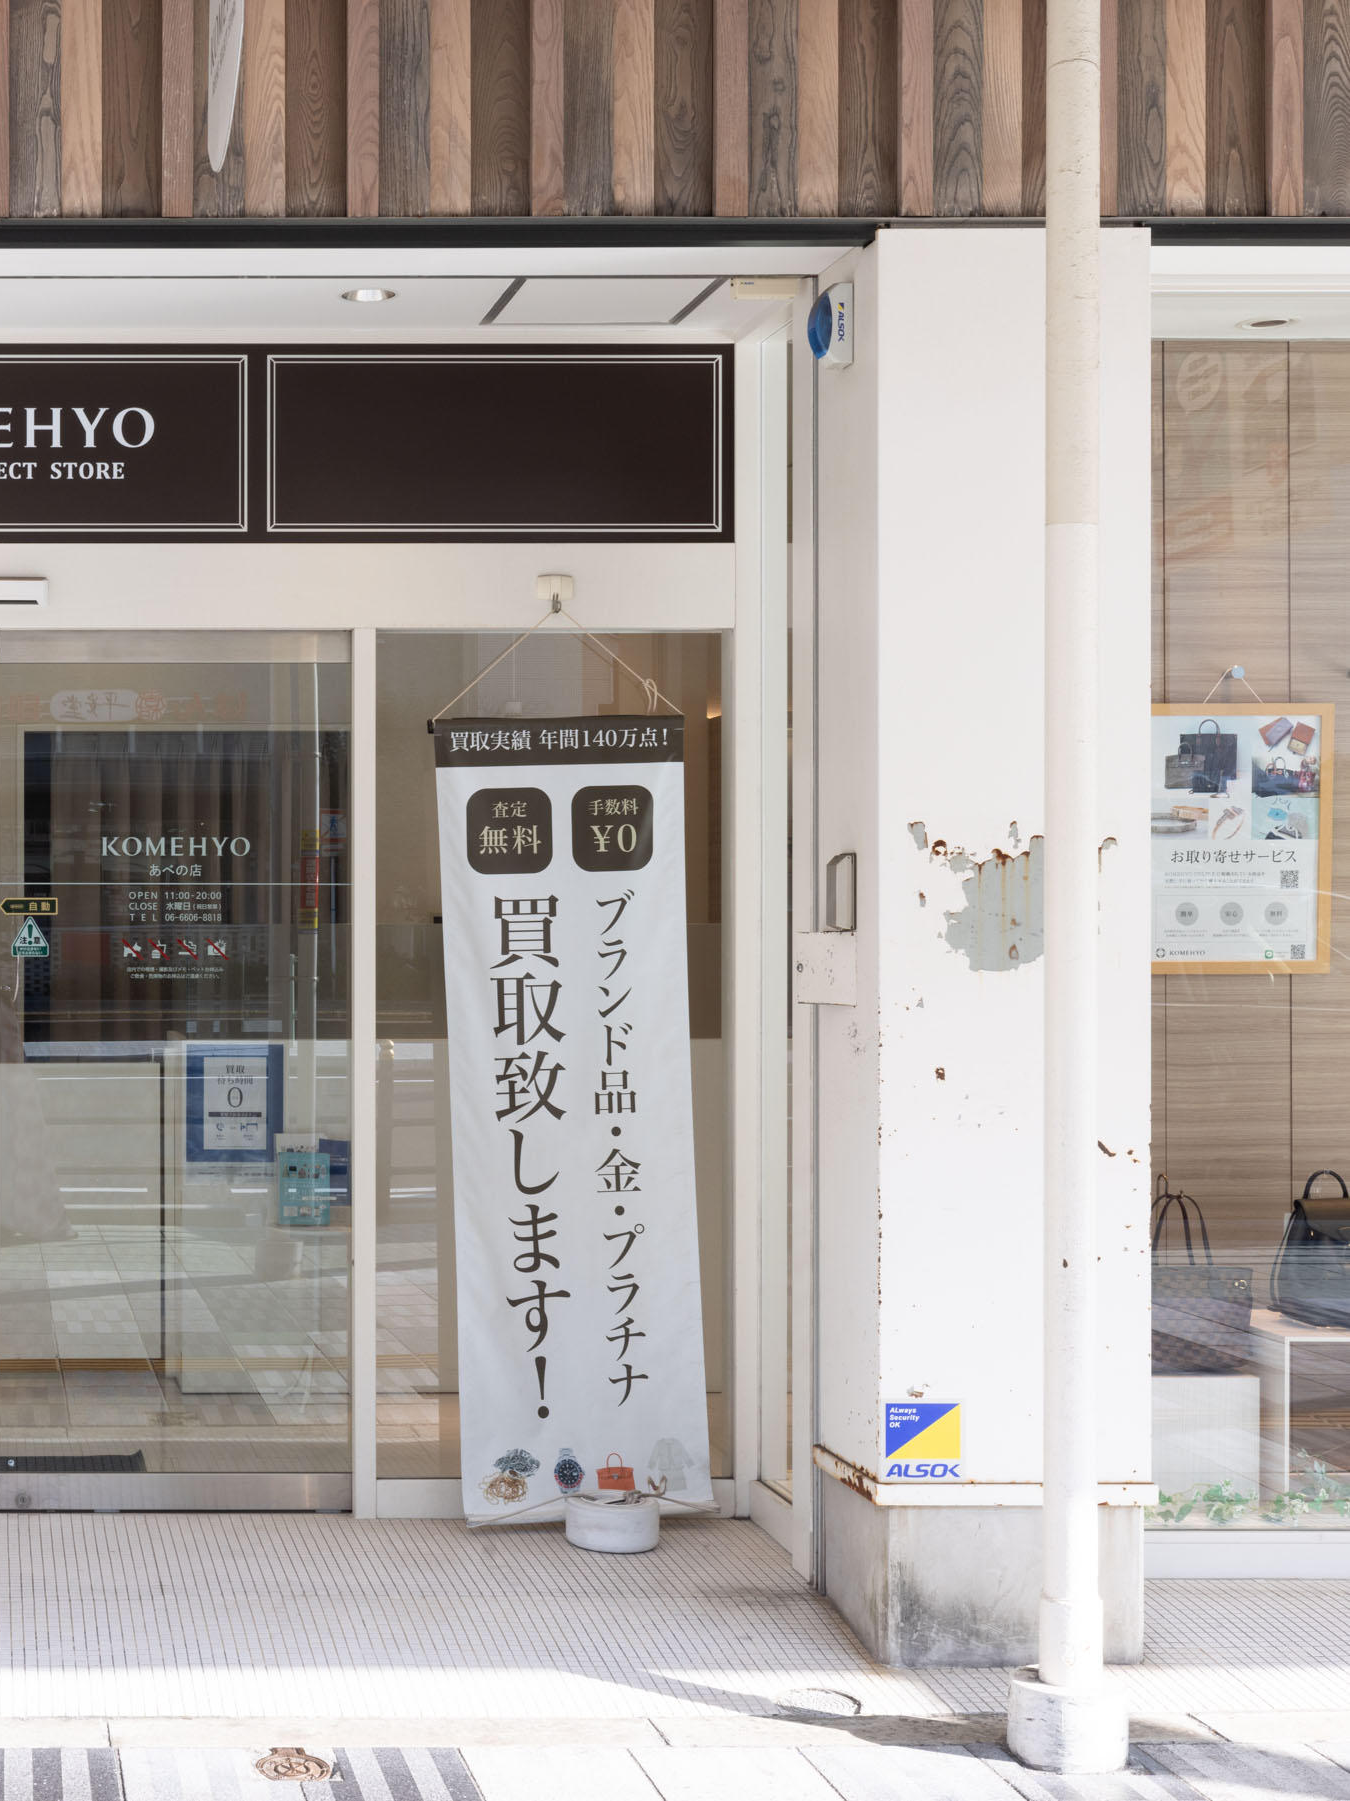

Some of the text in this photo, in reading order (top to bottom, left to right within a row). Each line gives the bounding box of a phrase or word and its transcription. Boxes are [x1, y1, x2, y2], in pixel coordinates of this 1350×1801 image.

[837, 311, 845, 342] ALSOK
[50, 461, 125, 480] STORE
[450, 728, 668, 751] 買取実績 年間140万点！
[492, 801, 527, 819] 査定
[588, 798, 639, 816] 手数料
[102, 836, 250, 857] KOMEHYO
[479, 825, 541, 854] 無料
[590, 823, 637, 853] ¥0
[1170, 849, 1297, 864] お取り寄せサービス
[149, 864, 202, 877] あべの店
[129, 891, 221, 900] OPEN 11:00-20:00
[29, 901, 50, 911] 自動
[129, 902, 158, 911] CLOSE
[165, 902, 190, 911] 水曜日
[165, 913, 221, 922] 06-6606-8818
[19, 936, 41, 945] 注意
[227, 1086, 243, 1108] 0
[594, 888, 649, 1407] ブランド品・金・プラチナ
[489, 895, 571, 1419] 買取致します！
[890, 1414, 920, 1422] Security
[886, 1463, 960, 1478] ALSOK
